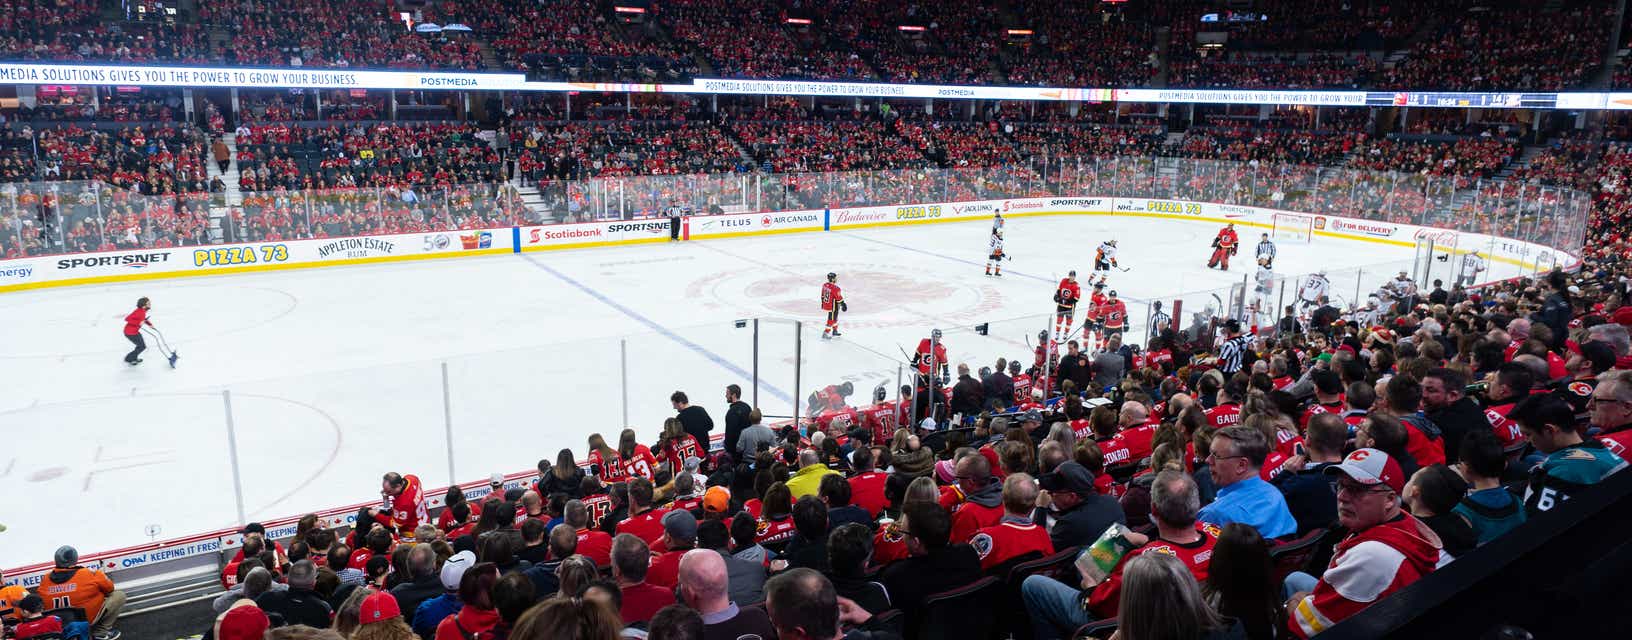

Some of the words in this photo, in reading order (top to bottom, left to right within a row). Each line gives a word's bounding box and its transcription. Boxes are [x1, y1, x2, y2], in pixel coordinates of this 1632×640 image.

[0, 68, 38, 80] MEDIA
[42, 69, 105, 81] SOLUTIONS
[109, 70, 141, 82] GIVES
[144, 70, 166, 82] YOU
[170, 71, 189, 83] THE
[193, 71, 230, 83] POWER
[234, 72, 245, 84] TO
[249, 72, 279, 84] GROW
[283, 73, 308, 84] YOUR
[312, 73, 358, 85] BUSINESS.
[421, 77, 478, 86] POSTMEDIA
[705, 81, 740, 91] POSTMEDIA
[742, 82, 774, 92] SOLUTIONS
[776, 83, 793, 92] GIVES
[794, 83, 806, 93] YOU
[807, 84, 817, 93] THE
[818, 84, 838, 94] POWER
[839, 85, 847, 94] TO
[848, 85, 864, 94] GROW
[865, 86, 879, 95] YOUR
[938, 88, 975, 96] POSTMEDIA
[1159, 92, 1195, 100] POSTMEDIA
[1196, 92, 1231, 100] SOLUTIONS
[1233, 93, 1251, 101] GIVES
[1255, 93, 1268, 101] YOU
[1270, 93, 1282, 101] THE
[1283, 94, 1307, 102] POWER
[1320, 94, 1341, 103] GROW
[1011, 201, 1044, 209] Scotiabank
[1146, 200, 1183, 213] PIZZA
[1186, 203, 1202, 215] 73
[836, 210, 887, 223] Budweiser
[896, 206, 926, 219] PIZZA
[928, 205, 941, 217] 73
[720, 218, 751, 228] TELUS
[773, 215, 787, 225] AIR
[787, 214, 818, 225] CANADA
[608, 222, 670, 233] SPORTSNE
[1358, 225, 1393, 234] DELIVERY
[544, 228, 602, 240] Scotiabank
[318, 238, 363, 258] APPLETON
[364, 237, 395, 254] ESTATE
[57, 252, 171, 269] SPORTSNET
[194, 247, 256, 266] PIZZA
[260, 244, 289, 262] 73
[1307, 279, 1322, 290] 37
[265, 526, 298, 540] KEEPING
[122, 554, 147, 568] OPA!
[150, 547, 186, 562] KEEPING
[187, 545, 195, 555] IT
